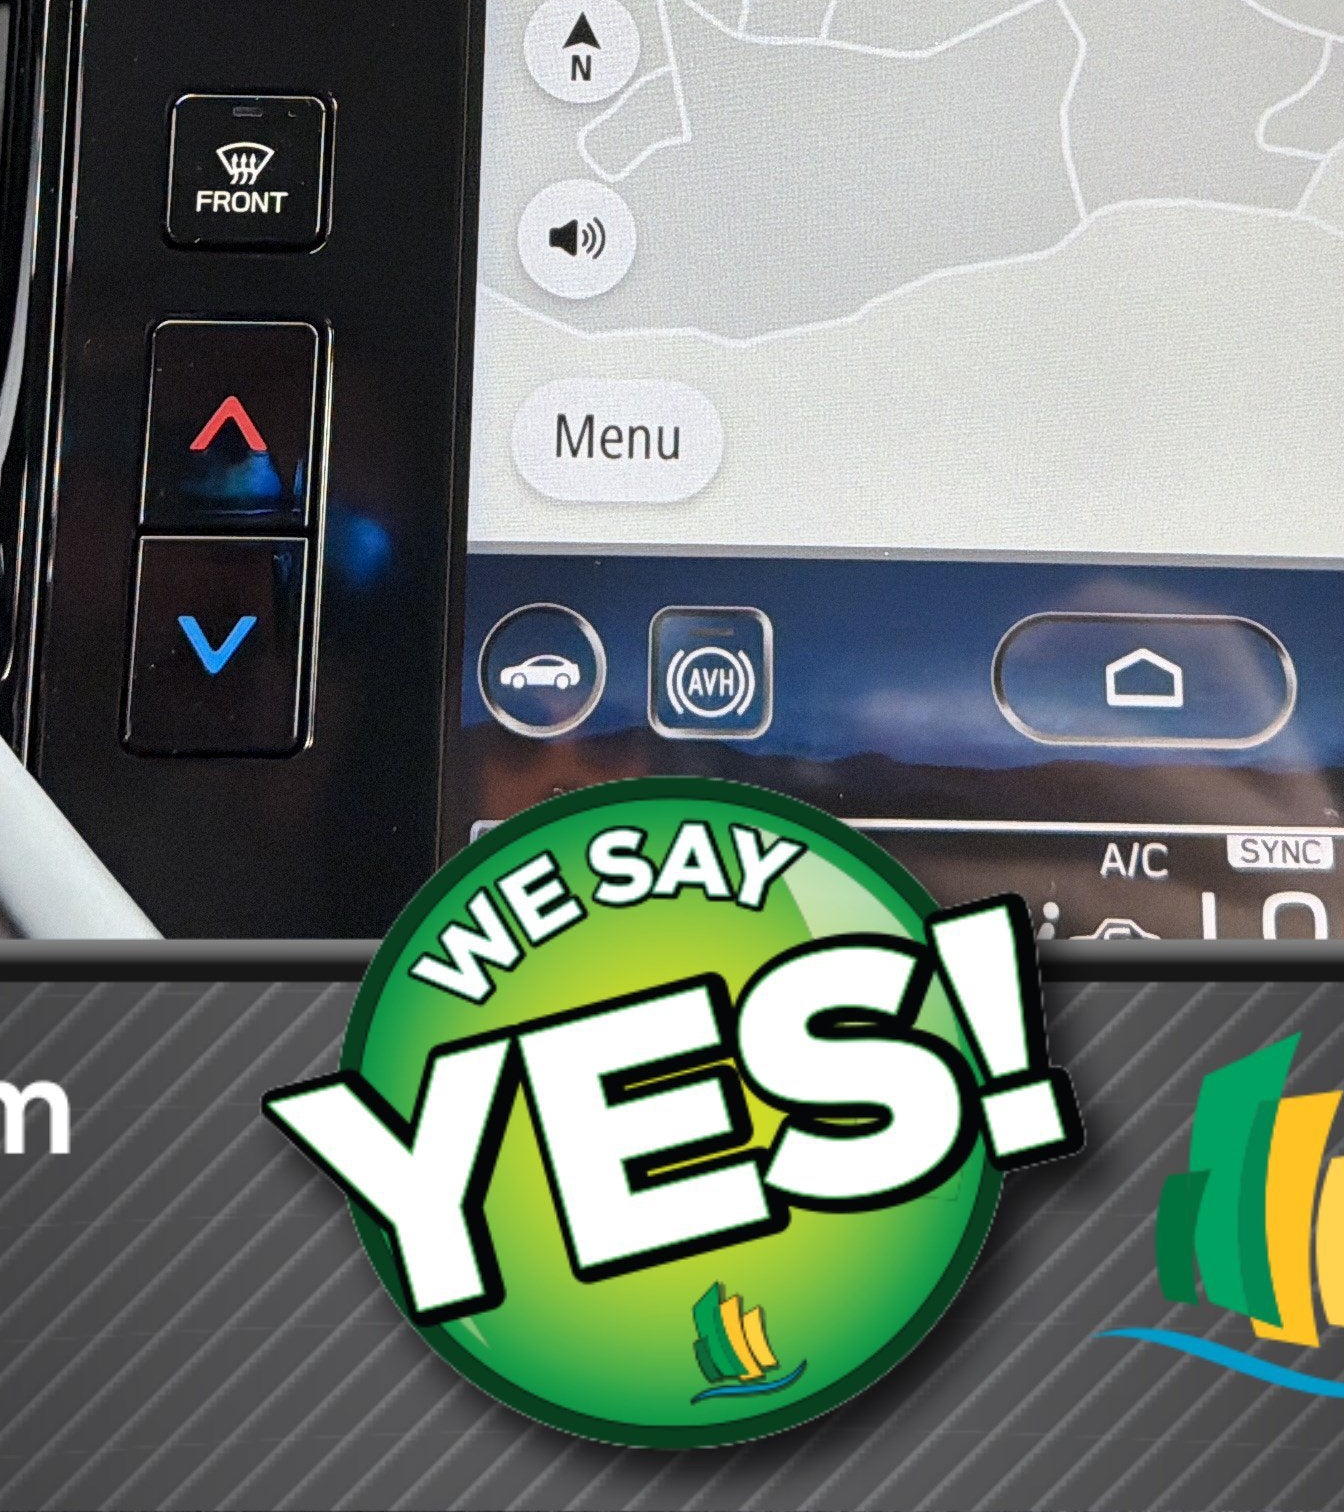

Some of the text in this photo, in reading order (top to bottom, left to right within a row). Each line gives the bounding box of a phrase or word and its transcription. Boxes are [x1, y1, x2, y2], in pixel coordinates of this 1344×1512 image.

[569, 54, 592, 82] N
[195, 190, 289, 215] FRONT
[555, 414, 681, 461] Menu
[687, 667, 734, 697] AVH
[1099, 841, 1170, 879] A/C
[1238, 837, 1324, 866] SYNC
